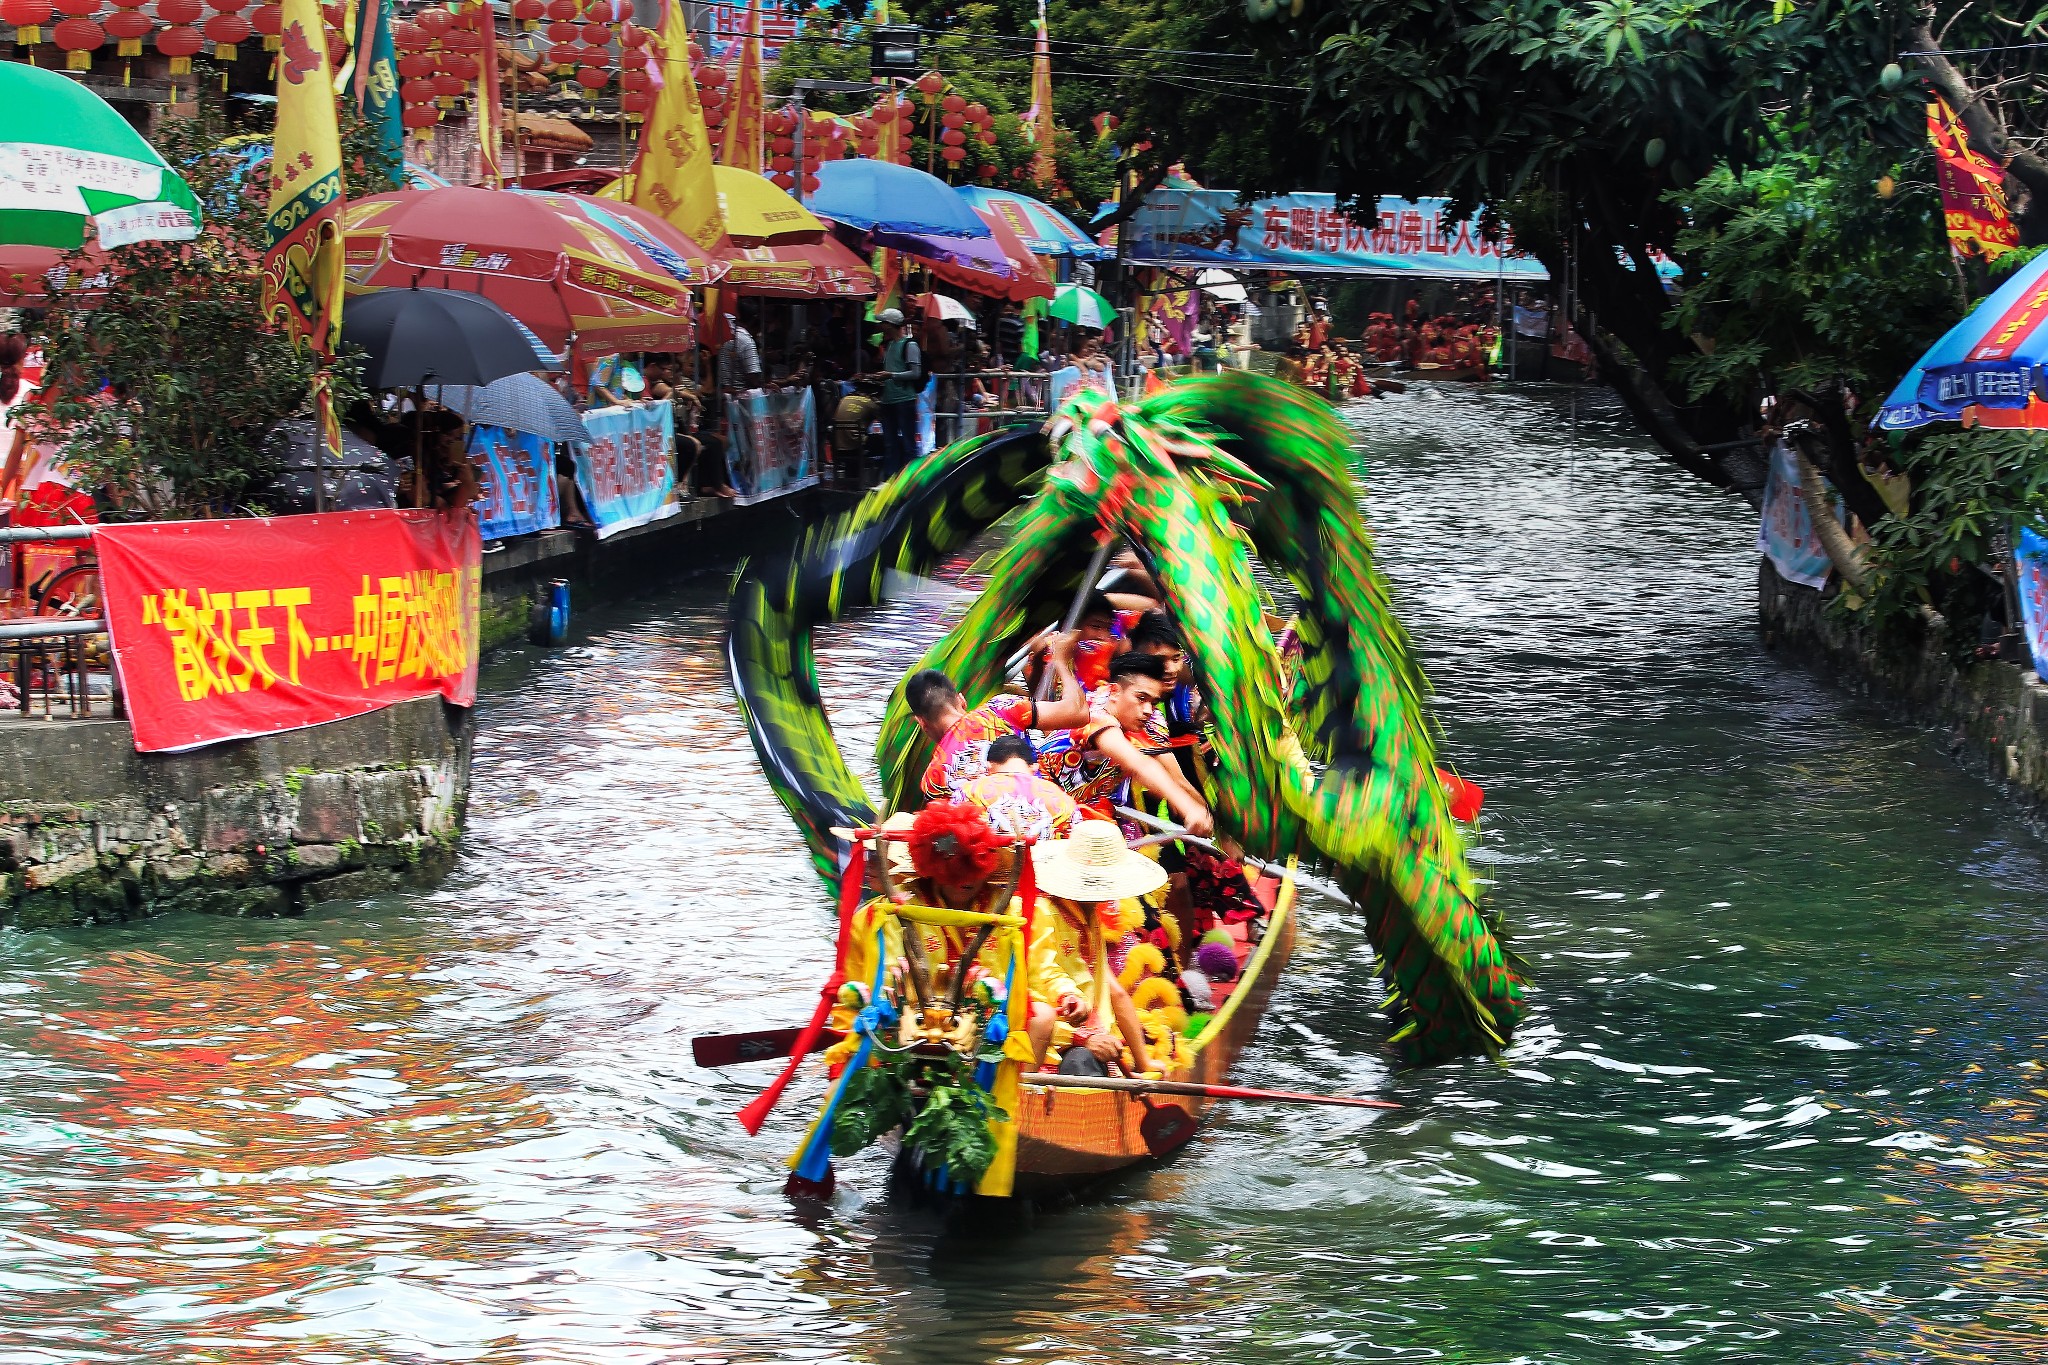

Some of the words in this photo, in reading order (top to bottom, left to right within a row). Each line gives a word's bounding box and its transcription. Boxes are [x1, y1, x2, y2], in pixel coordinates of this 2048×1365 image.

[1263, 205, 1527, 259] 东鹏特饮祝佛山人民
